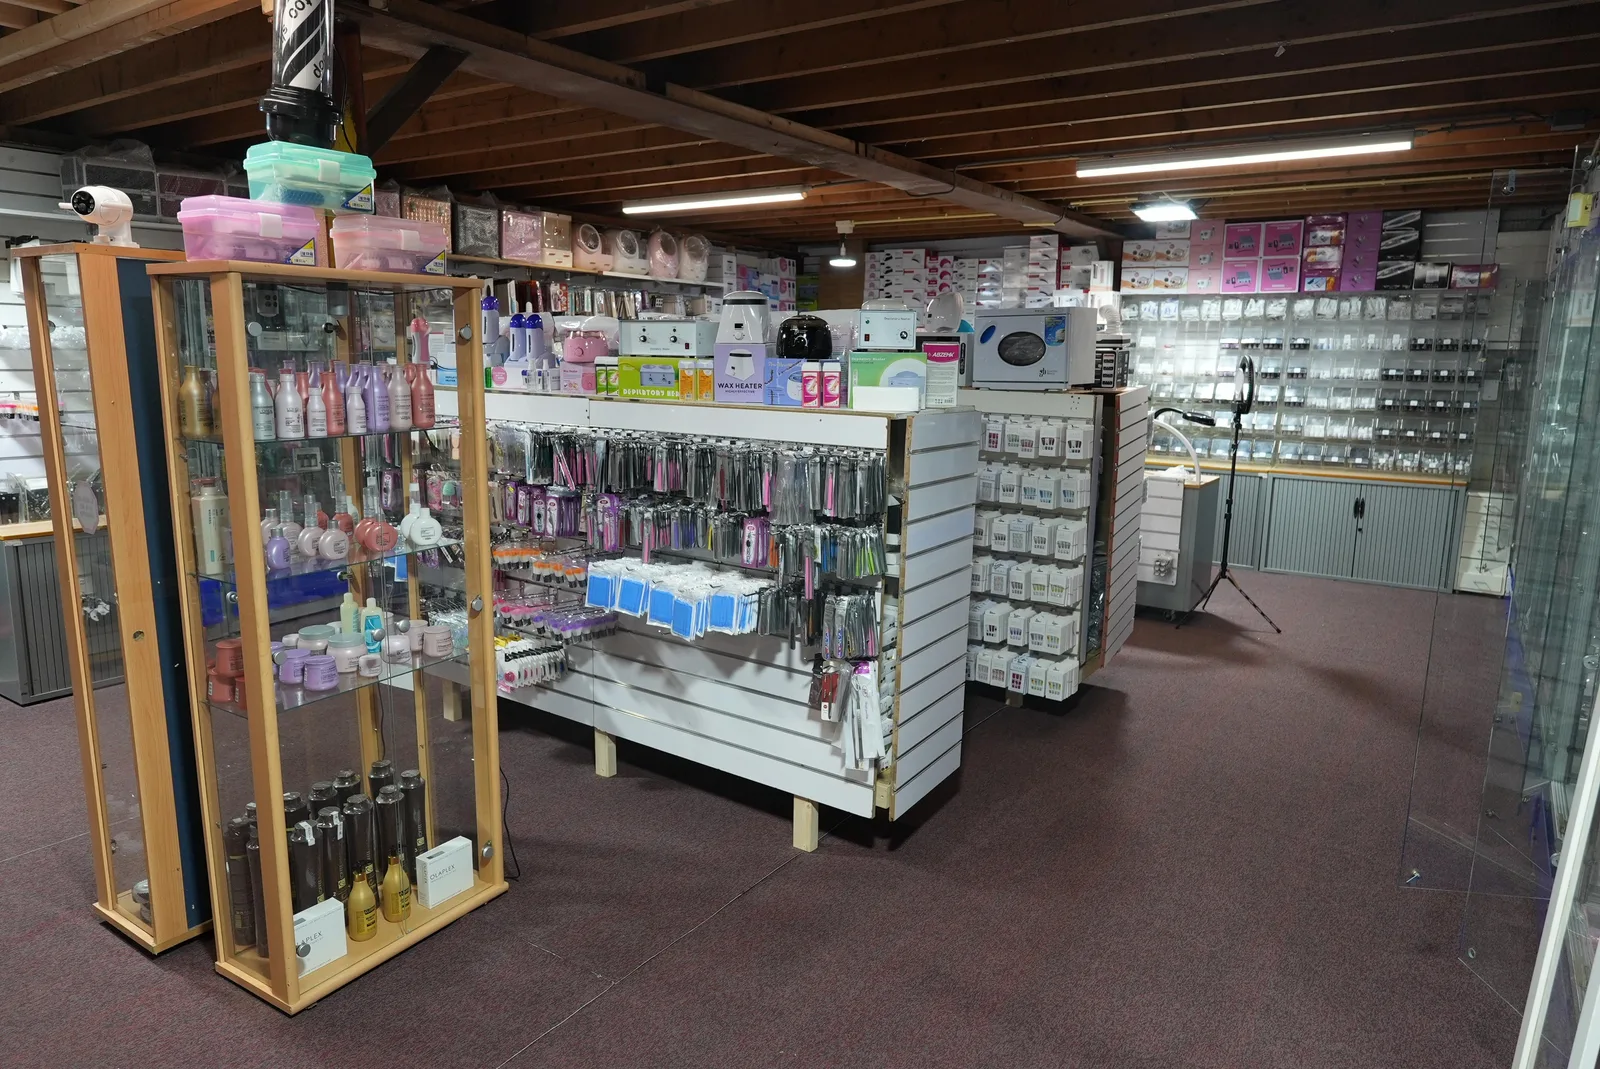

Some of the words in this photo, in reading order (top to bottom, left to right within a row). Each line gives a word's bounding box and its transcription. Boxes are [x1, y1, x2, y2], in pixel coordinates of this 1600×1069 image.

[735, 382, 763, 390] HEATER
[622, 388, 665, 397] DEPILATORY
[667, 389, 680, 397] HEA
[429, 863, 455, 880] OLAPLEX
[297, 931, 322, 946] APLEX
